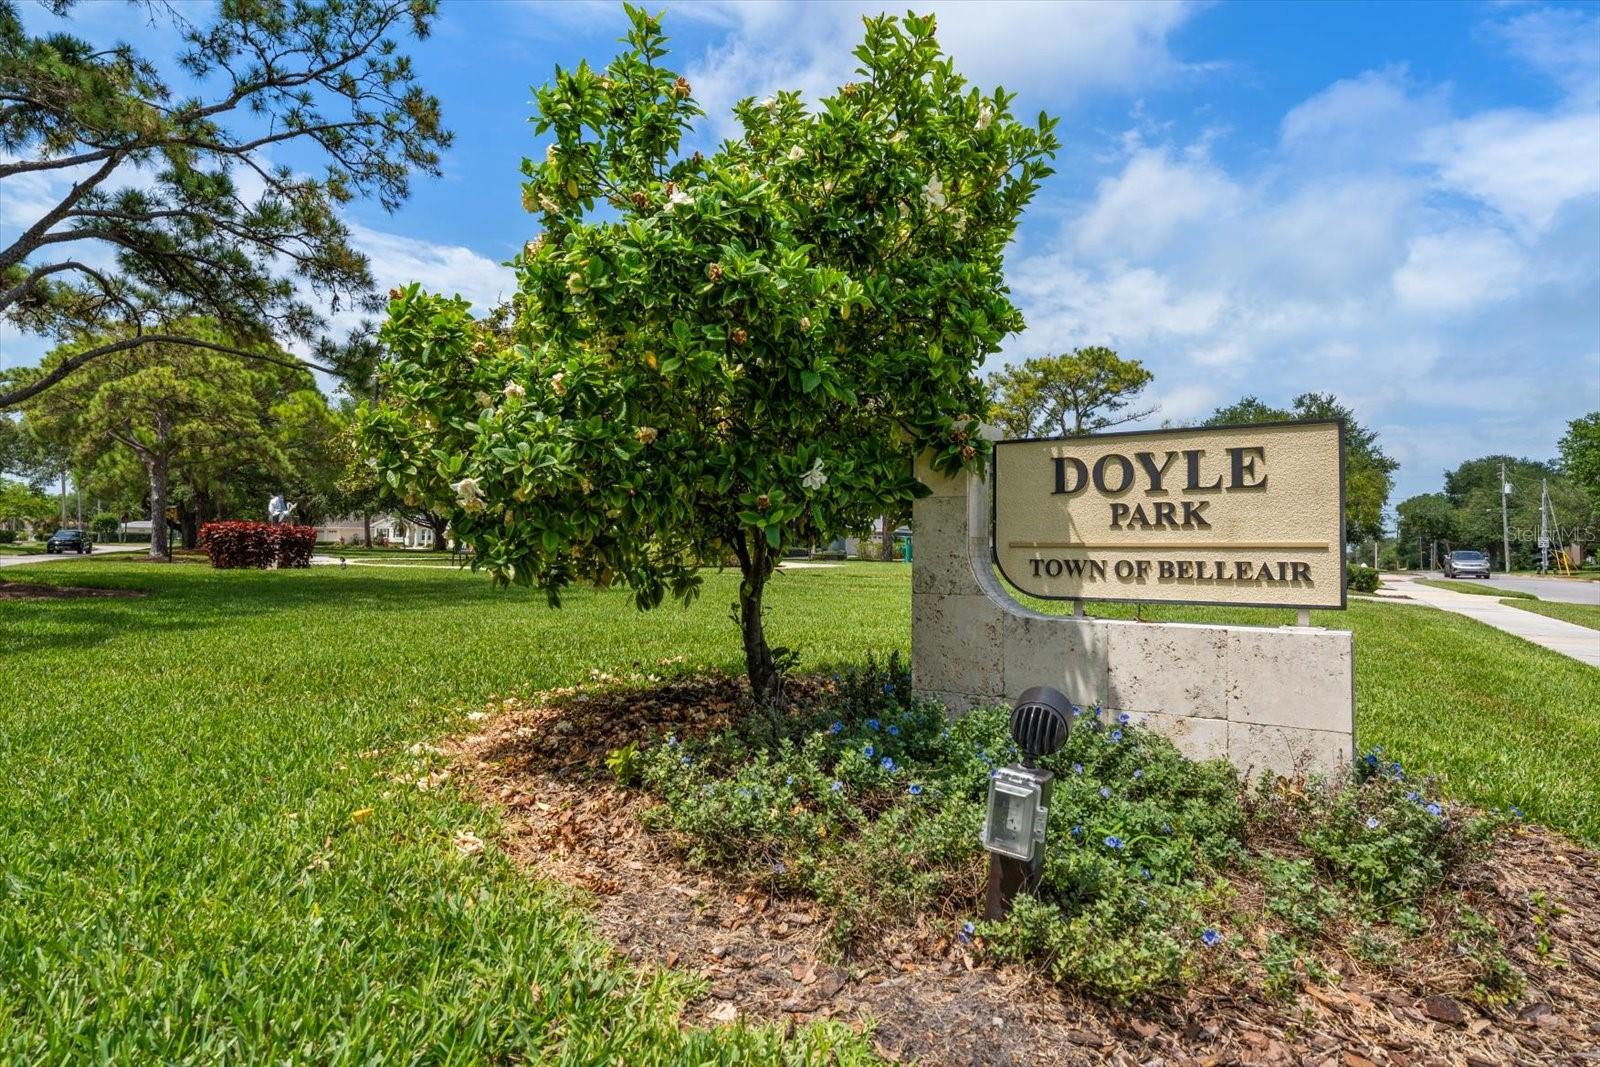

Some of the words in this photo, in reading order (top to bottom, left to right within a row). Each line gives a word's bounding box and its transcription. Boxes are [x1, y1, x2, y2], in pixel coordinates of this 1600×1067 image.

[1050, 446, 1268, 495] DOYLE
[1109, 500, 1212, 529] PARK
[1029, 558, 1106, 580] TOWN
[1114, 559, 1151, 580] OF
[1157, 560, 1314, 583] BELLEAIR
